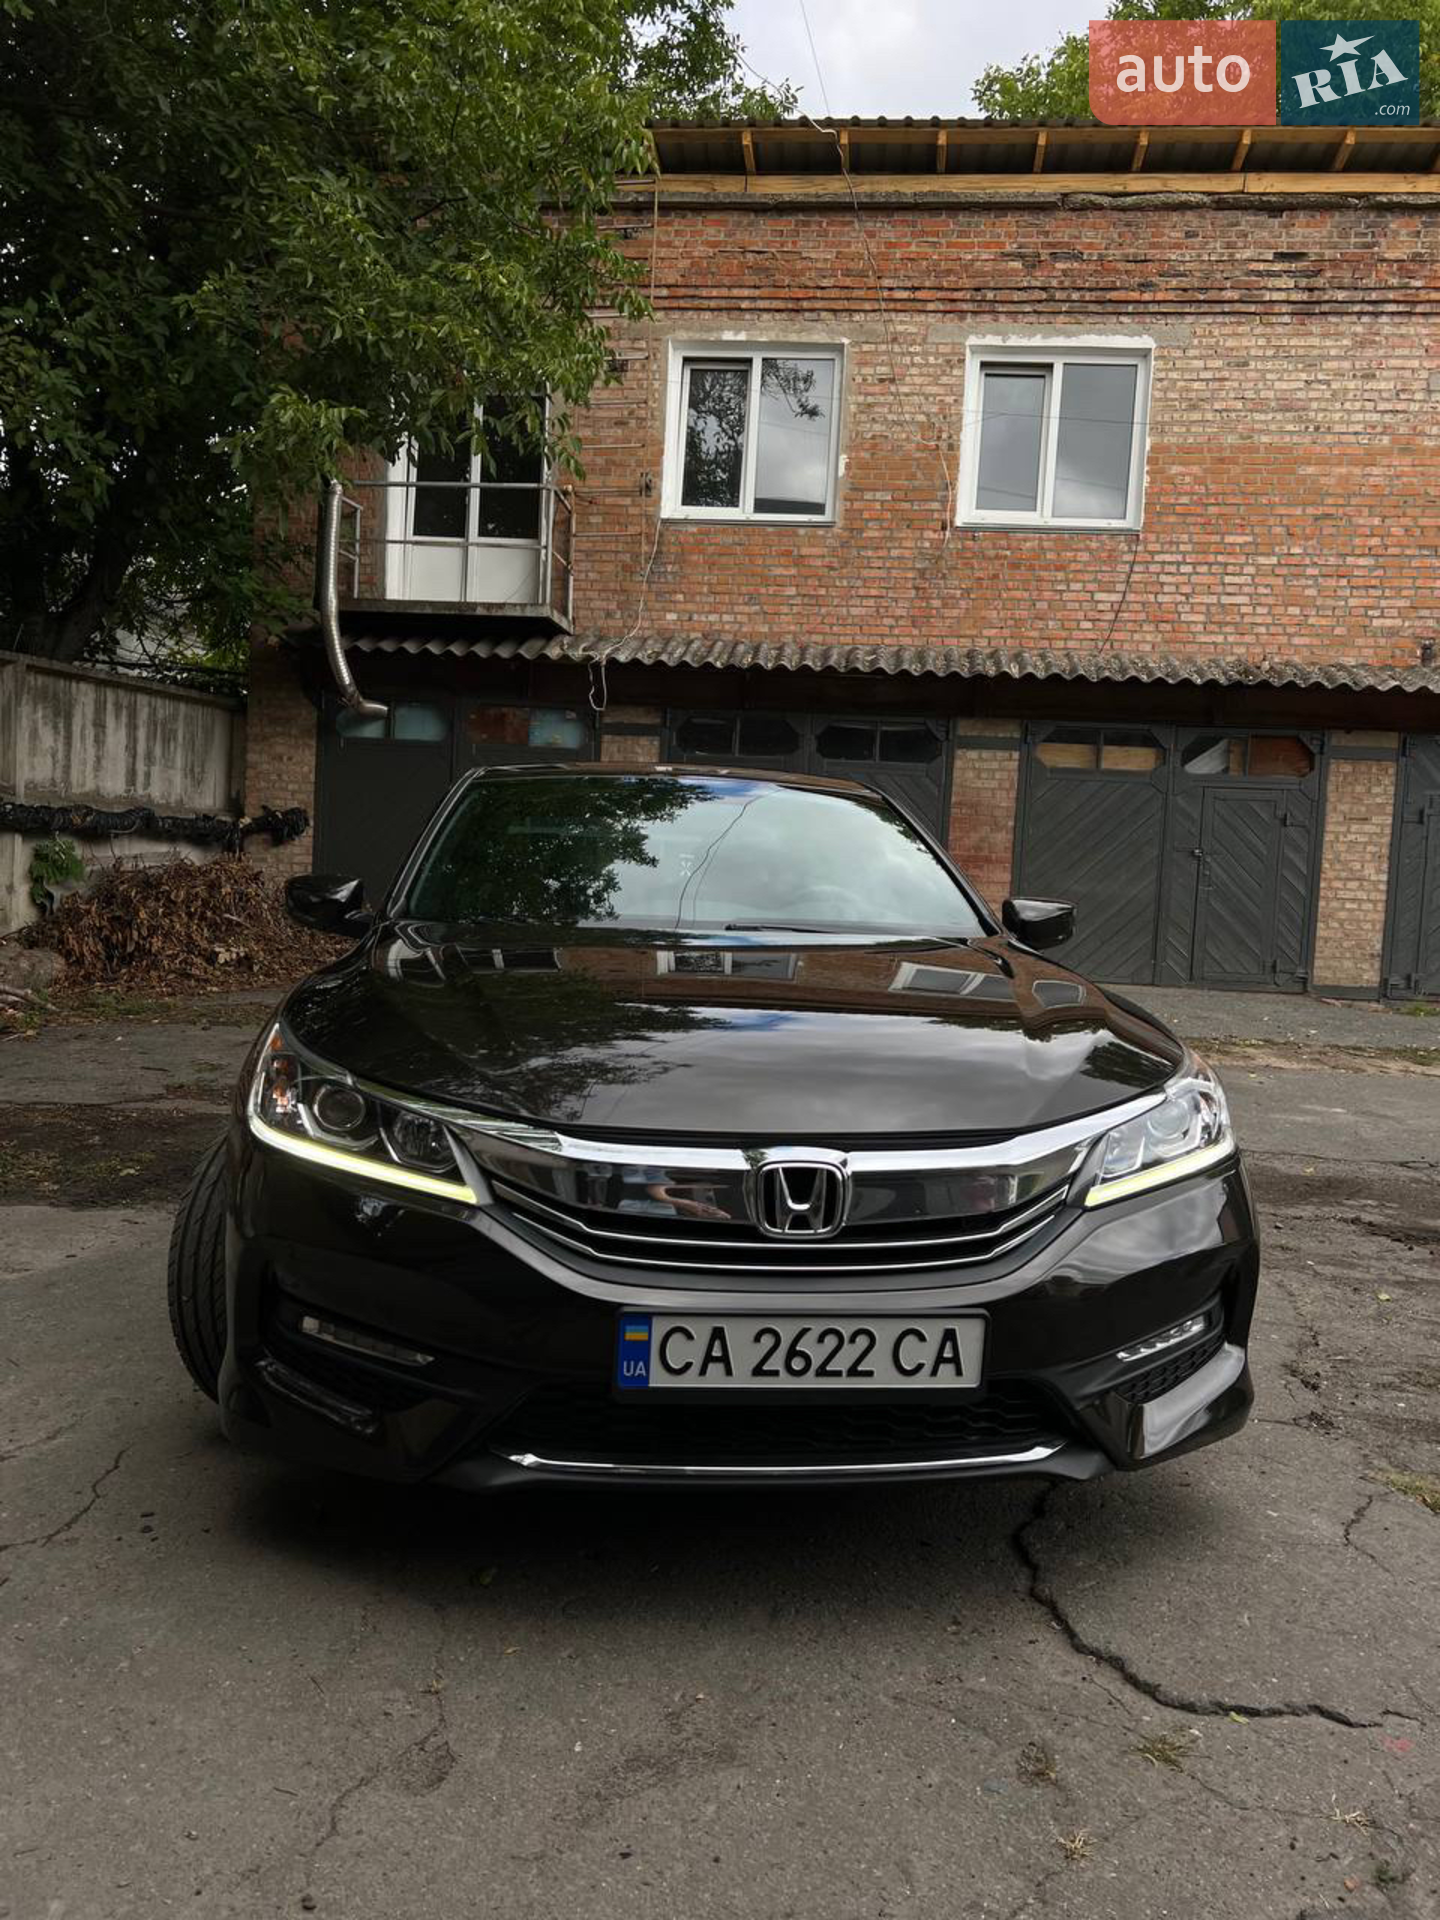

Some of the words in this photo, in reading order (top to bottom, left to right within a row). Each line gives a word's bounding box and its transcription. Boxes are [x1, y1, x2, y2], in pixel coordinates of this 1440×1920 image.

[623, 1361, 647, 1377] UA
[659, 1326, 734, 1377] CA
[751, 1327, 877, 1377] 2622
[892, 1328, 964, 1378] CA
